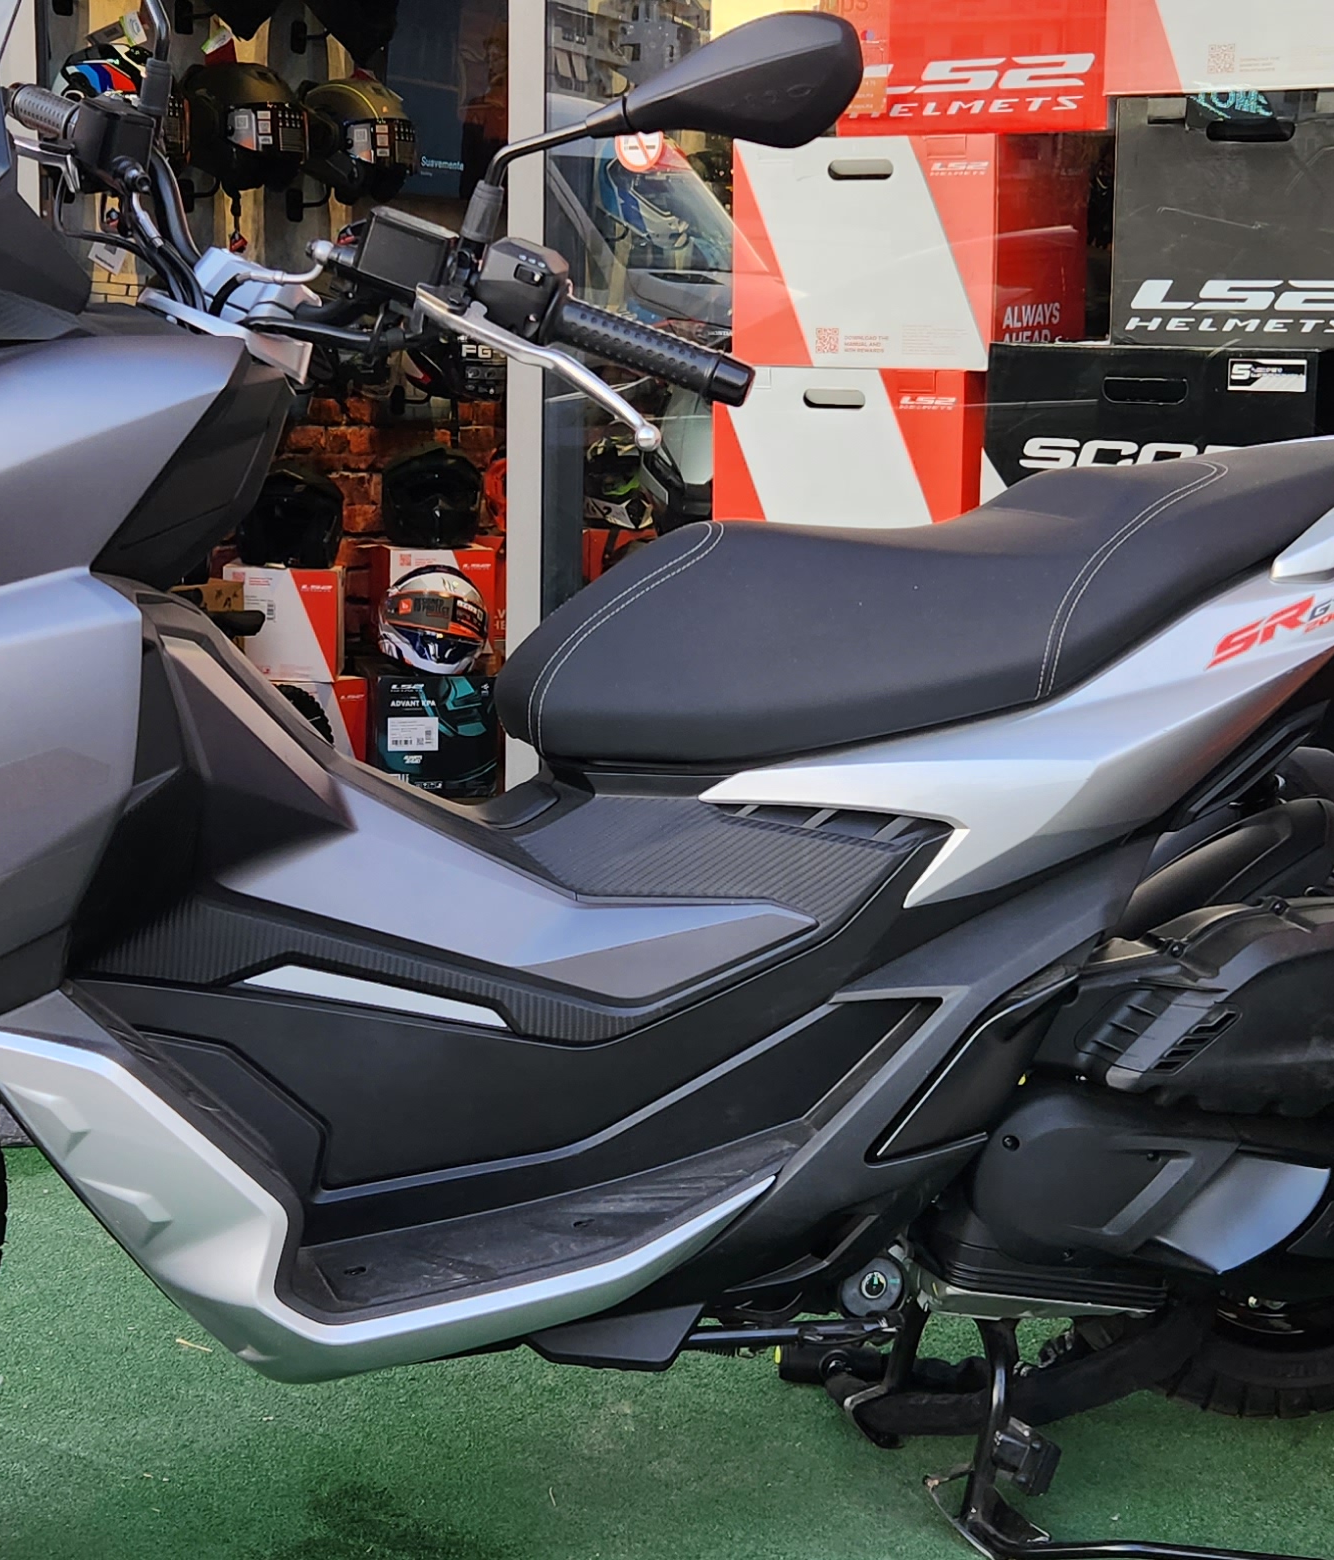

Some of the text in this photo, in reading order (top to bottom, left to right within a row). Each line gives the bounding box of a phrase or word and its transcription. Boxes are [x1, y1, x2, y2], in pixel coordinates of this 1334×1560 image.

[848, 95, 1084, 119] ELMETS
[930, 161, 989, 170] LS2
[1002, 302, 1060, 329] ALWAYS
[900, 396, 956, 405] LS2
[1019, 437, 1244, 469] SCO
[1205, 594, 1315, 671] SR
